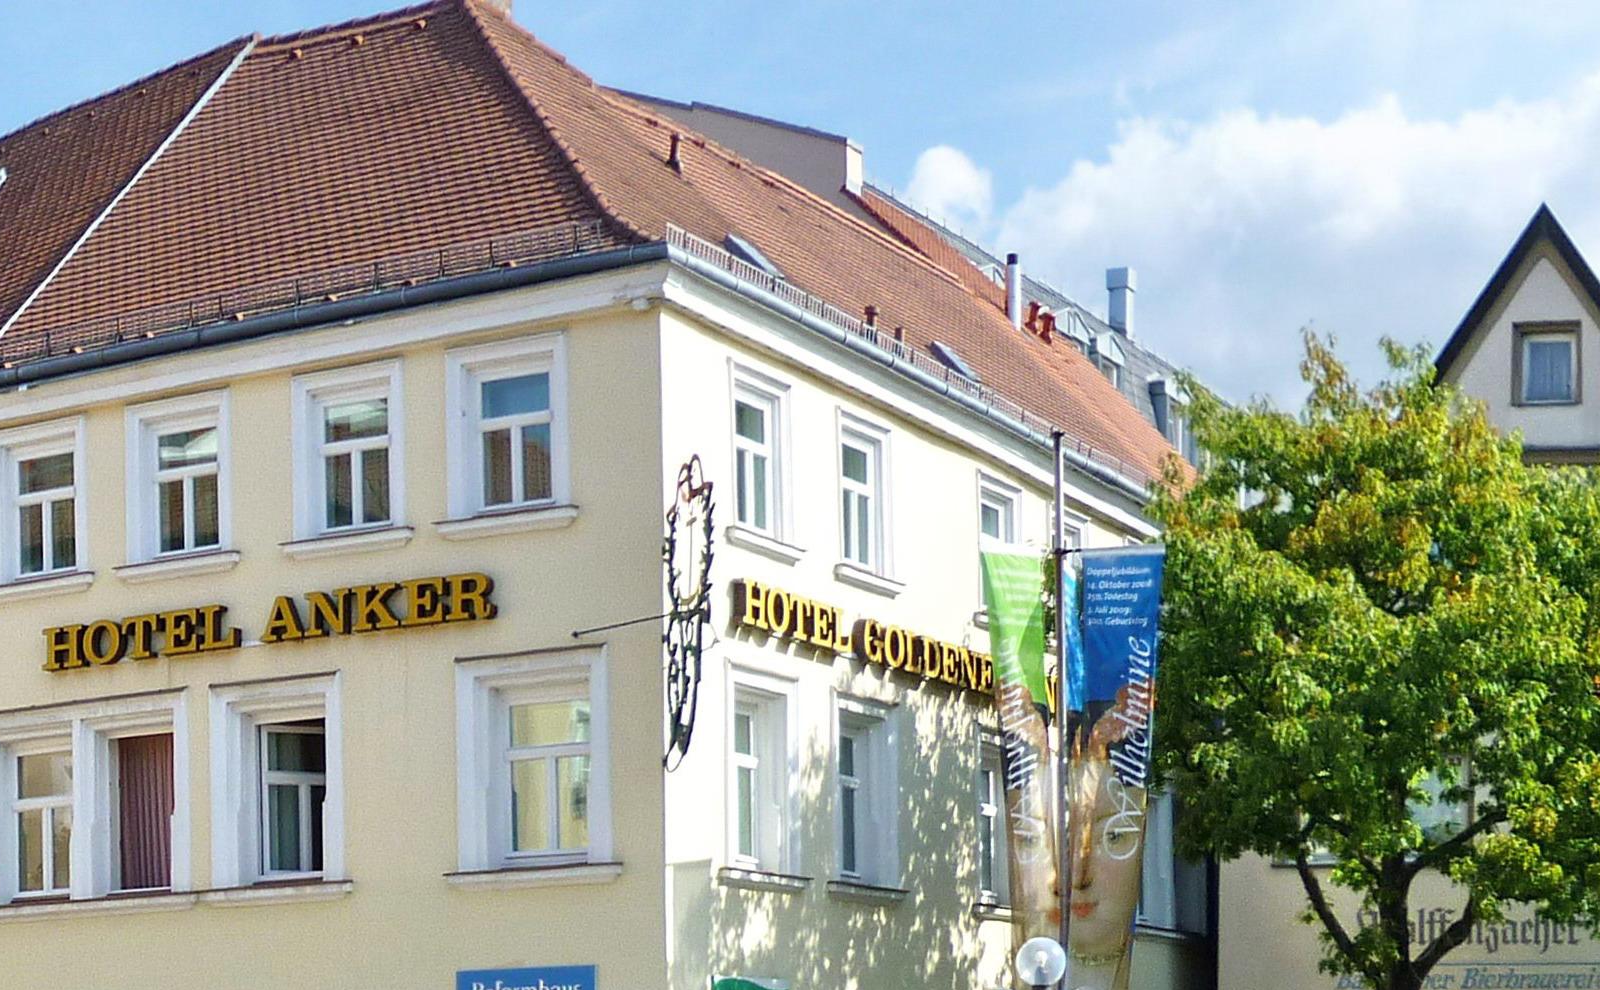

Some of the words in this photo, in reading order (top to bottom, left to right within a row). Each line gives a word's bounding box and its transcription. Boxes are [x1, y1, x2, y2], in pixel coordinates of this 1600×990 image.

[42, 603, 242, 672] HOTEL
[261, 572, 498, 643] ANKER
[742, 577, 853, 652] HOTEL
[1103, 636, 1152, 860] Wilhelmine
